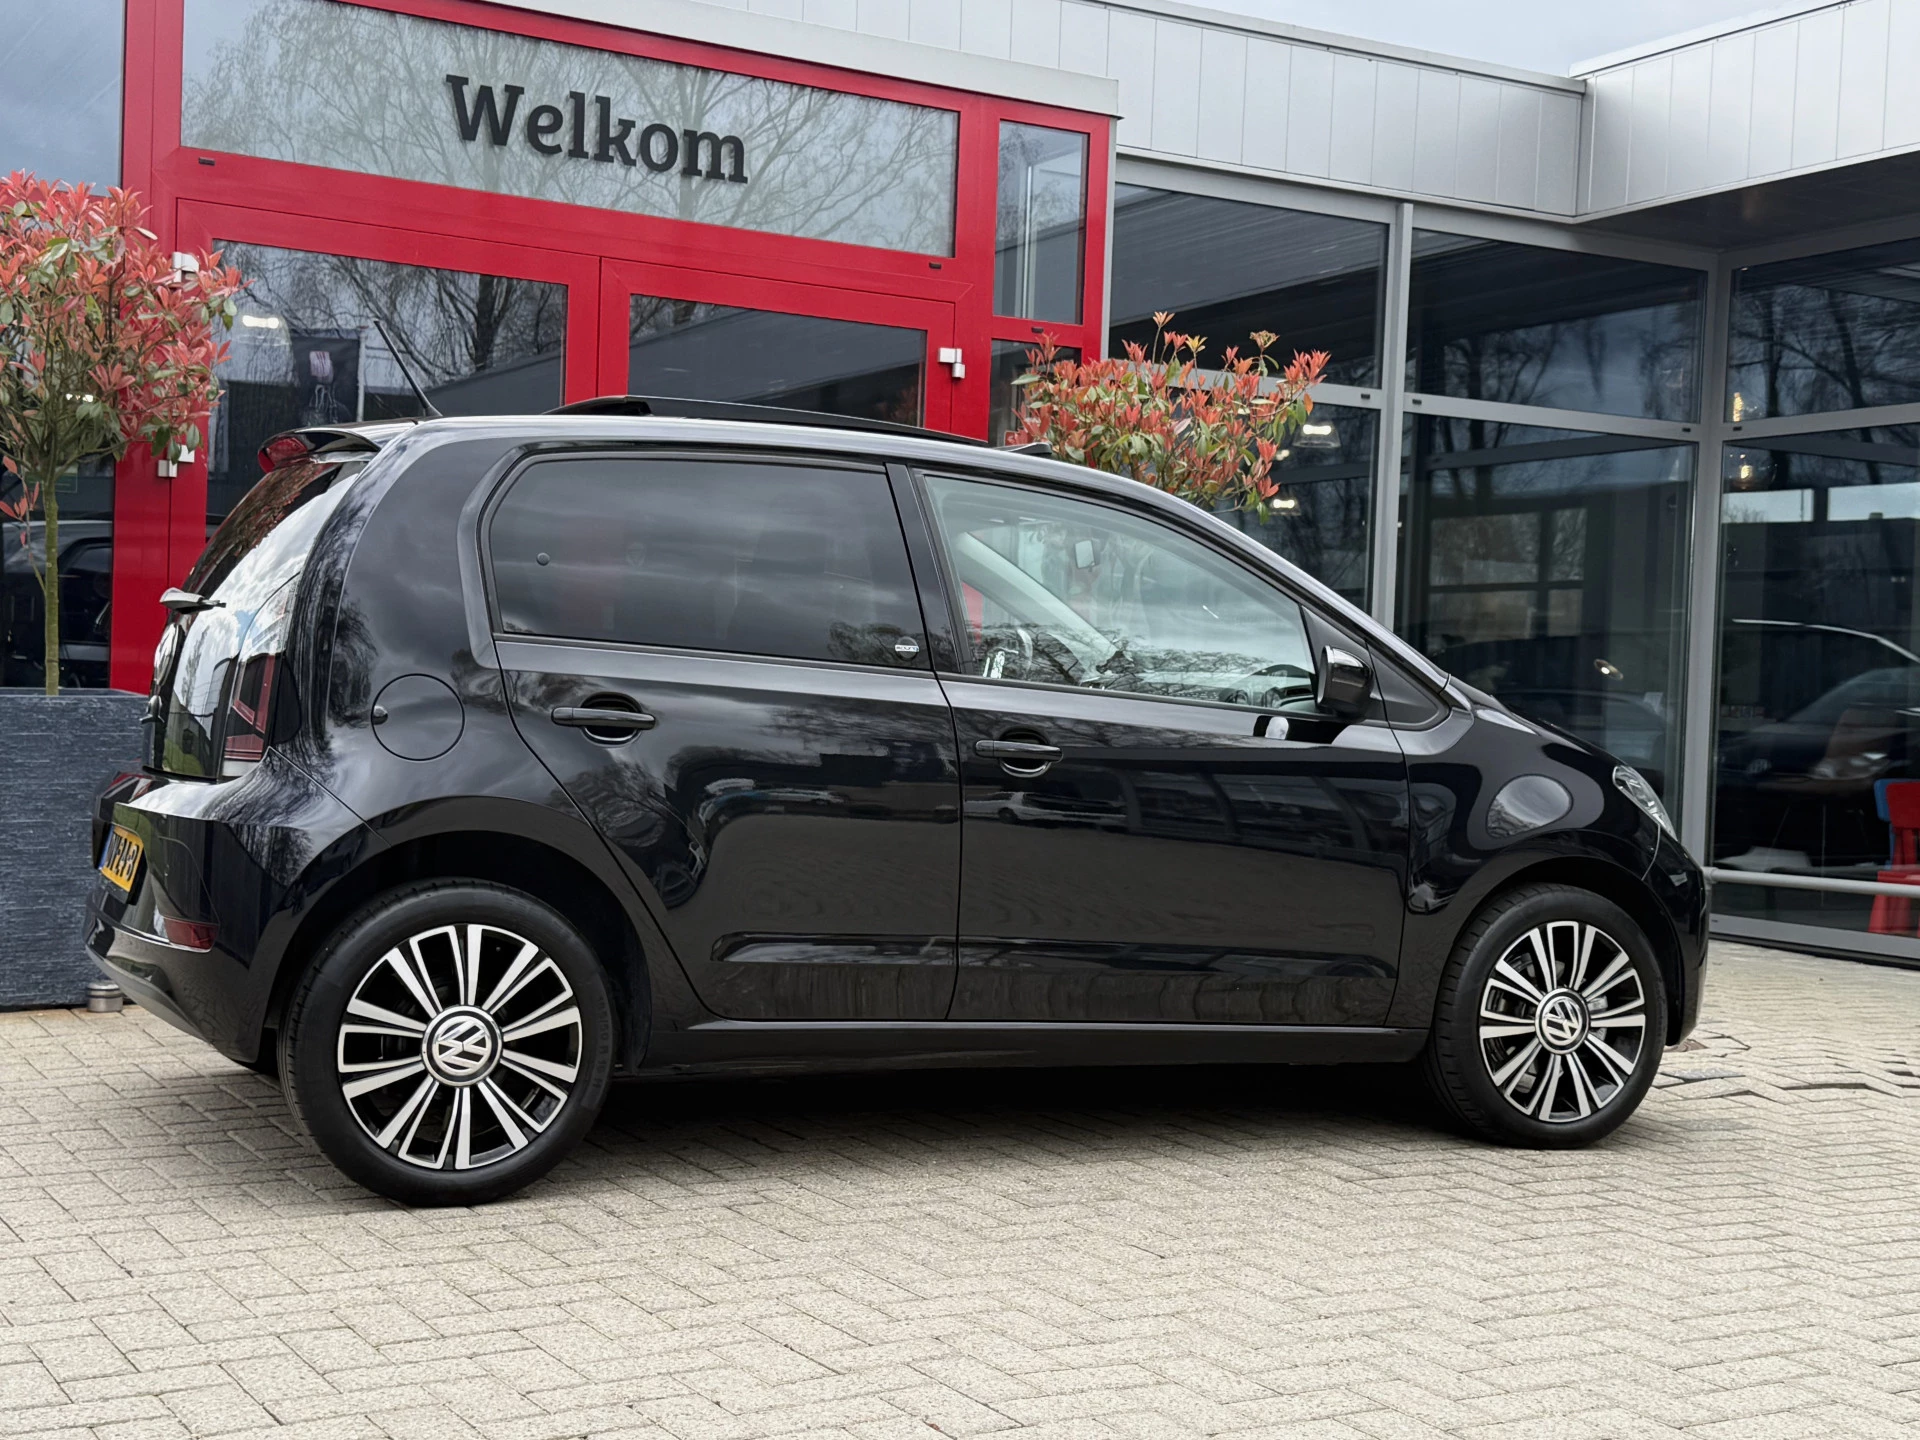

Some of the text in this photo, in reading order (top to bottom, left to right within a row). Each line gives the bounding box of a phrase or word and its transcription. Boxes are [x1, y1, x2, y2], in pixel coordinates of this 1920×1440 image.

[446, 74, 748, 183] Welkom
[432, 1015, 492, 1076] VW
[1542, 995, 1583, 1046] VW
